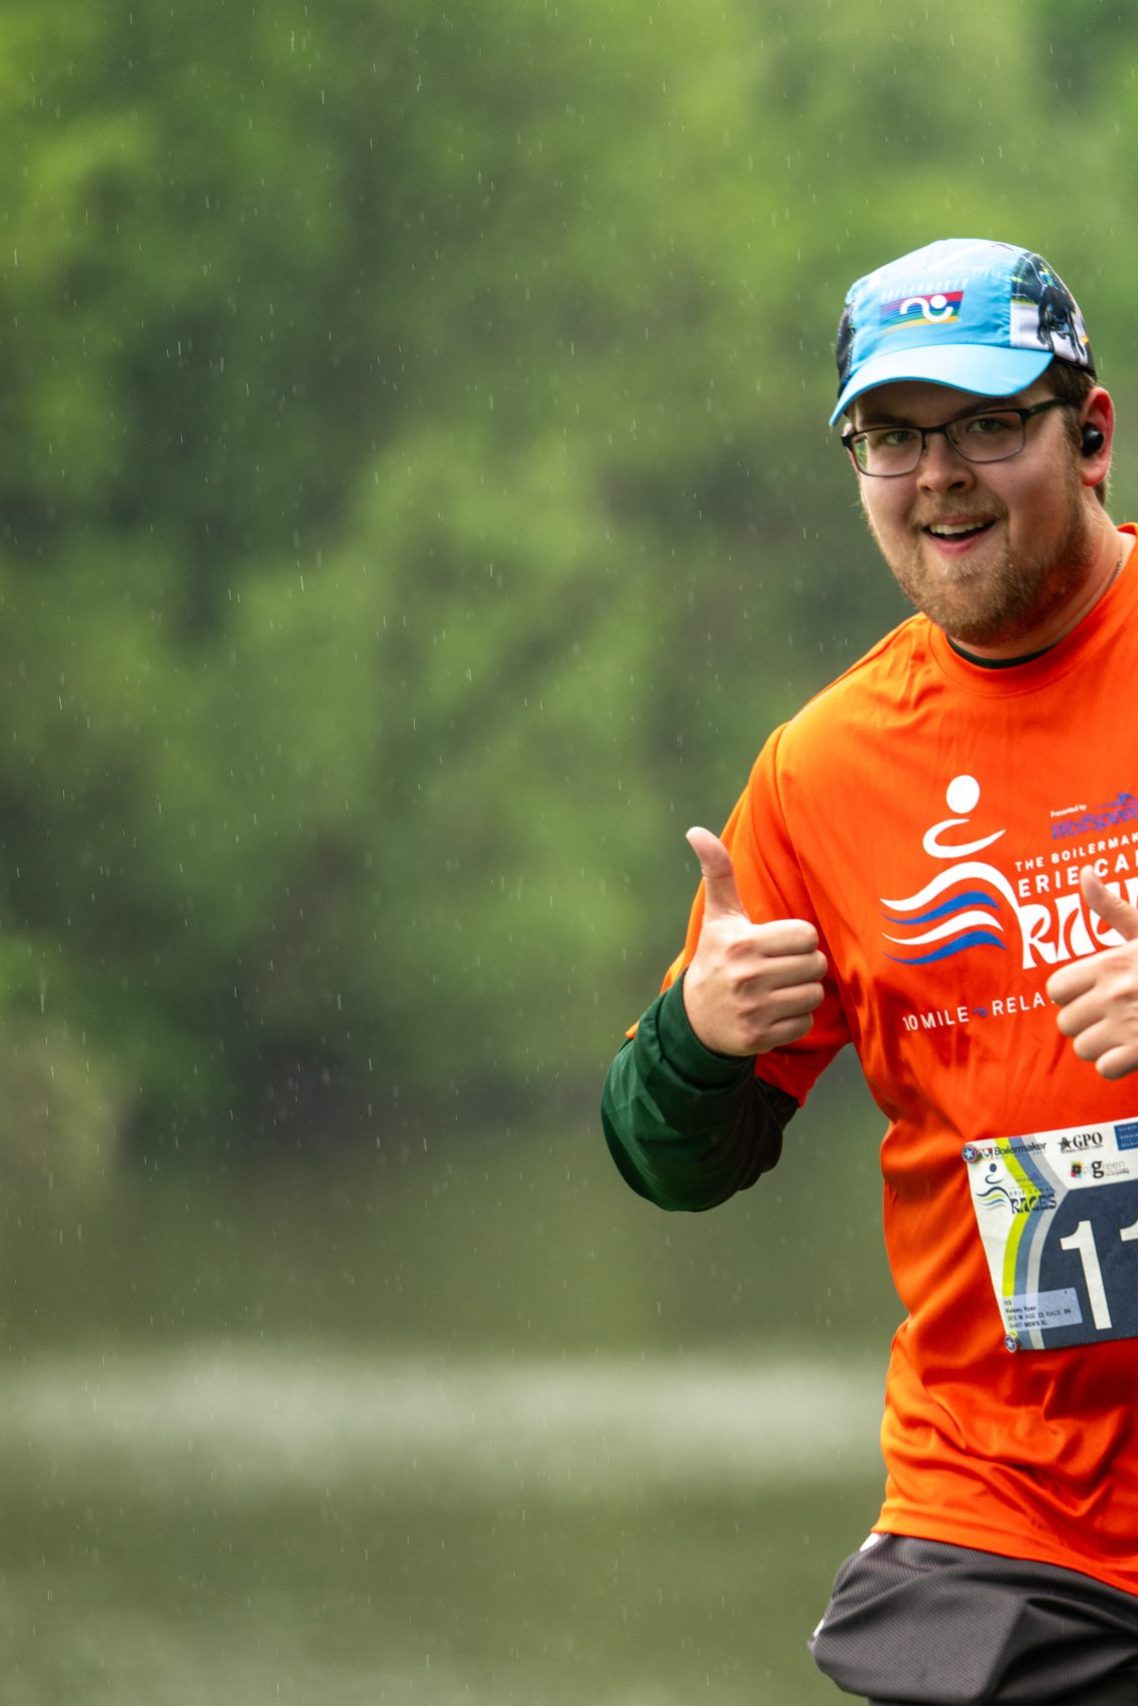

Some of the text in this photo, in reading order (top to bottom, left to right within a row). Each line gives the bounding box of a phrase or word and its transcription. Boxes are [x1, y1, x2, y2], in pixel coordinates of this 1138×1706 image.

[1015, 856, 1045, 873] THE
[1018, 866, 1080, 898] ERIE
[992, 991, 1056, 1016] RELA
[1072, 1131, 1103, 1148] GPO
